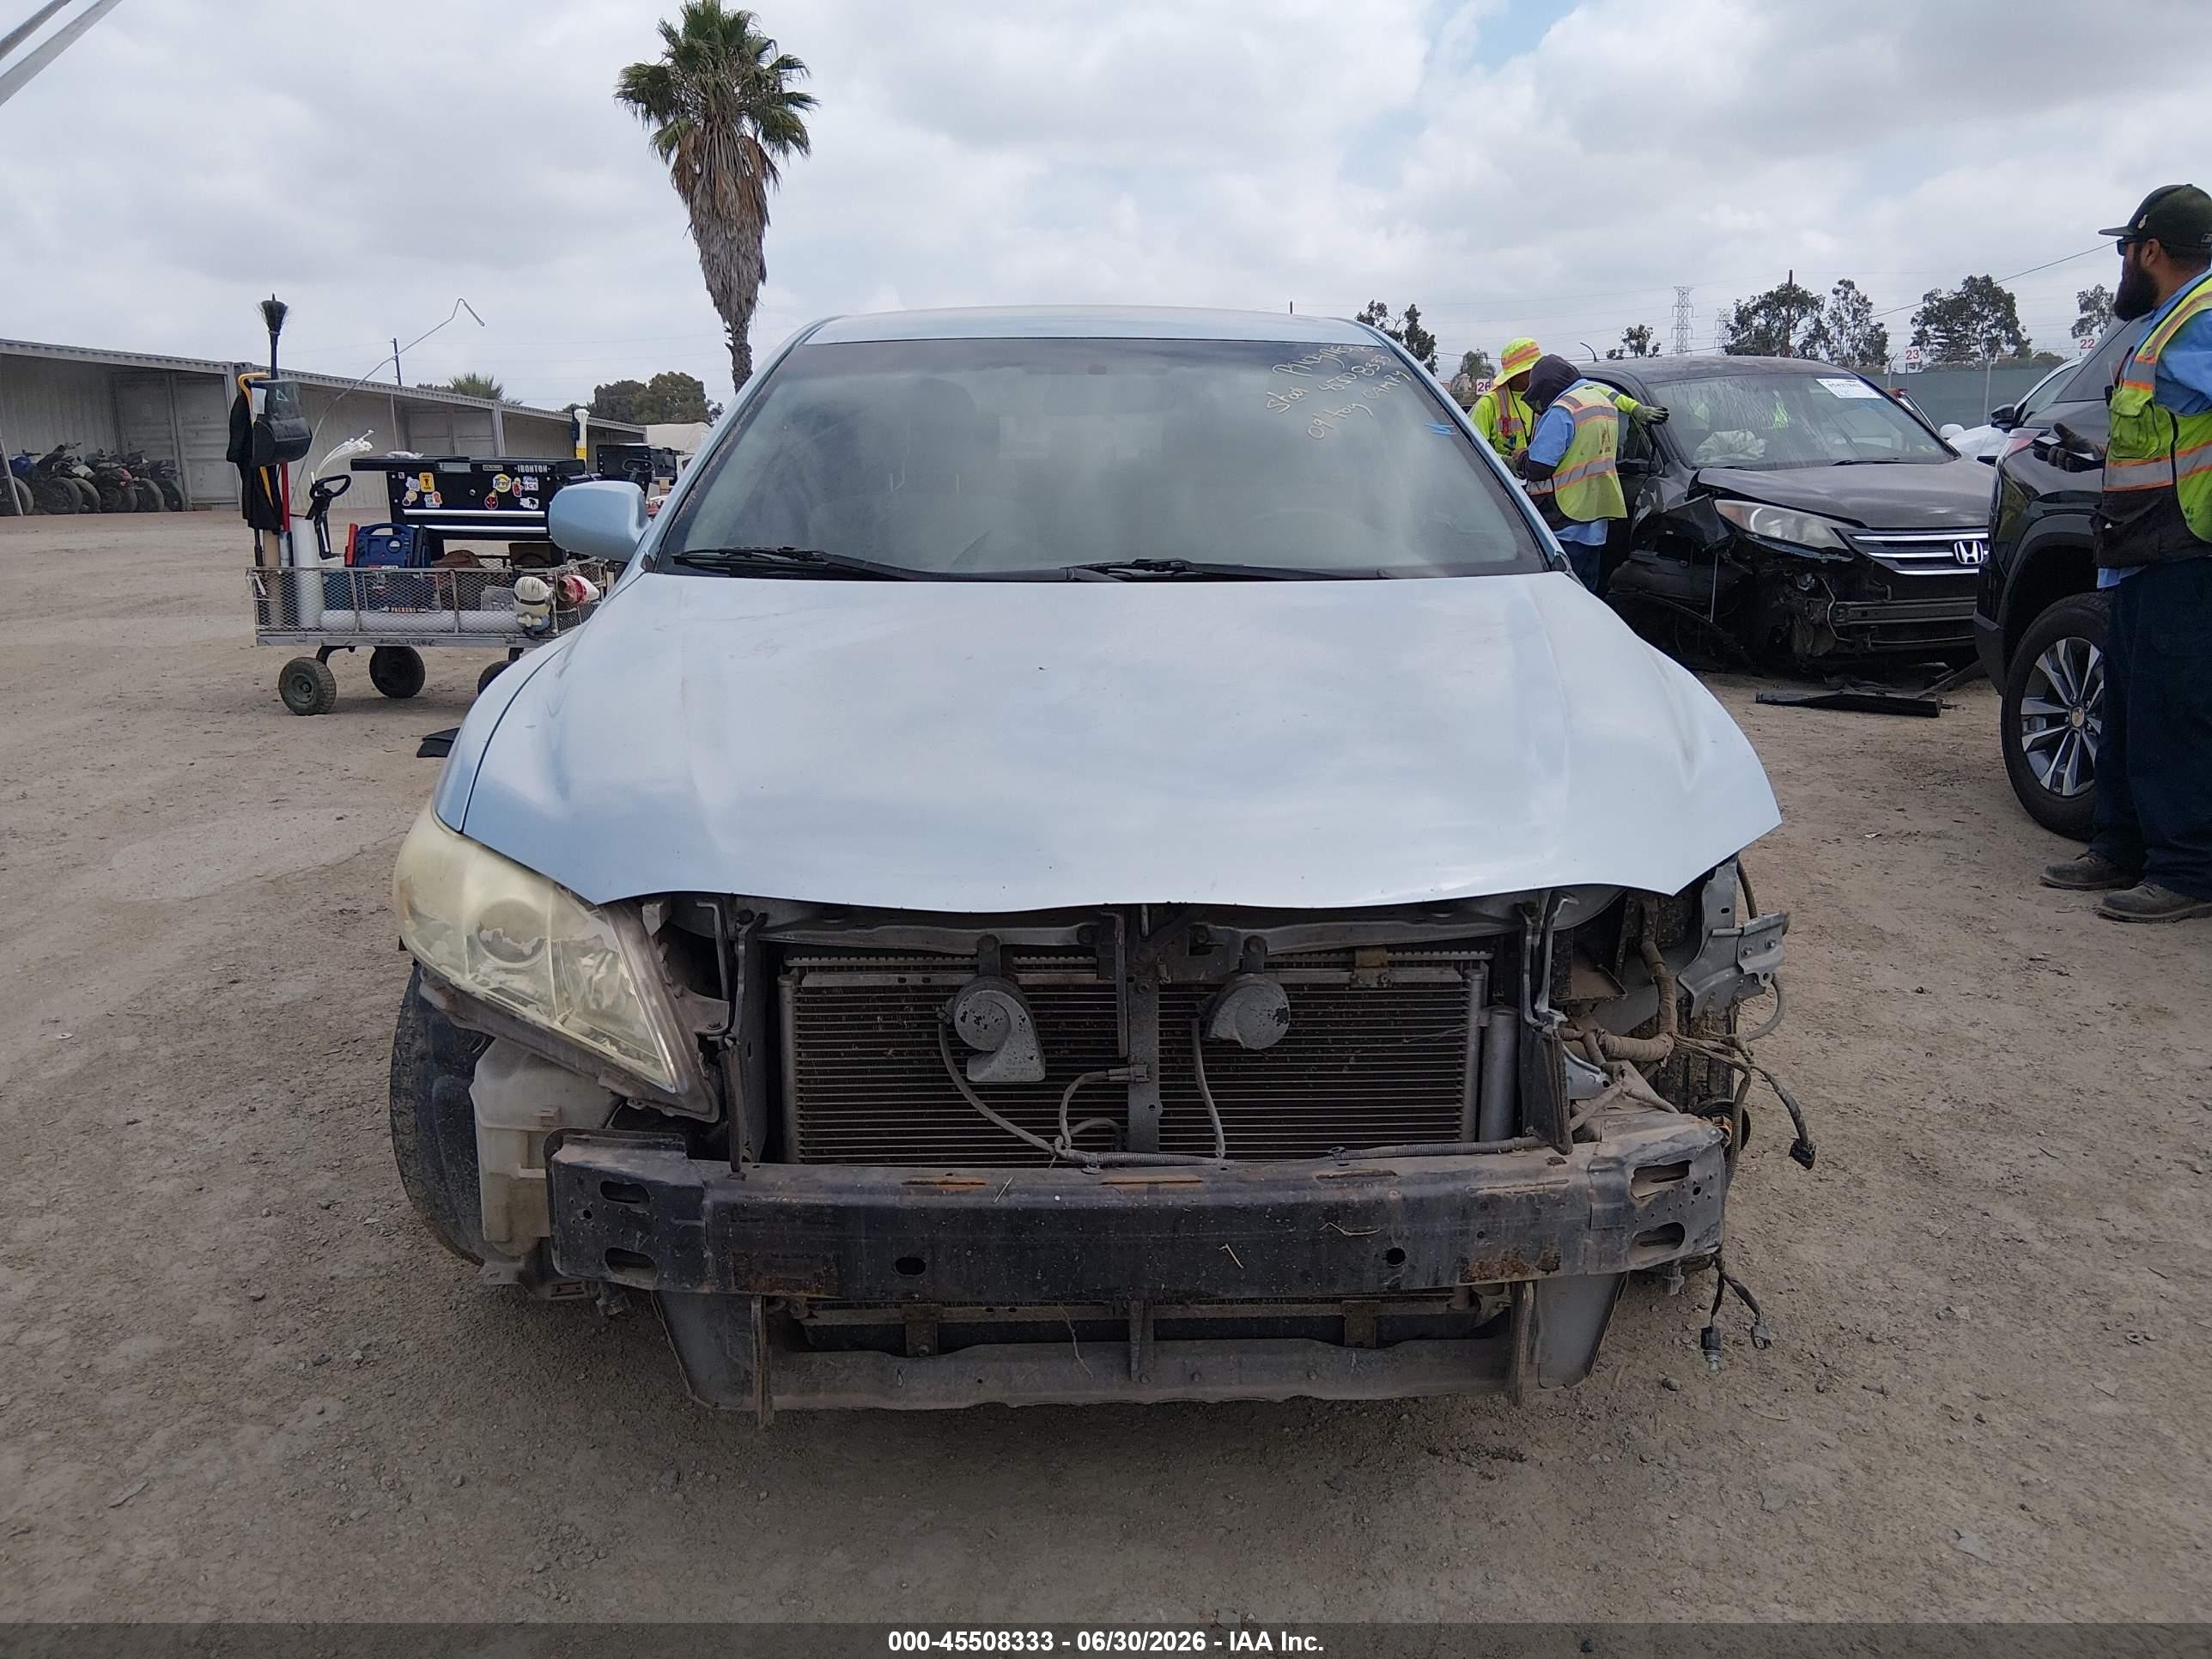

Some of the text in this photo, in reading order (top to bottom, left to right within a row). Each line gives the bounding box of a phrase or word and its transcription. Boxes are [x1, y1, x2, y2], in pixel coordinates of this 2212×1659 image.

[2080, 338, 2095, 349] 22
[1905, 349, 1920, 360] 23
[517, 465, 548, 473] IRONTON
